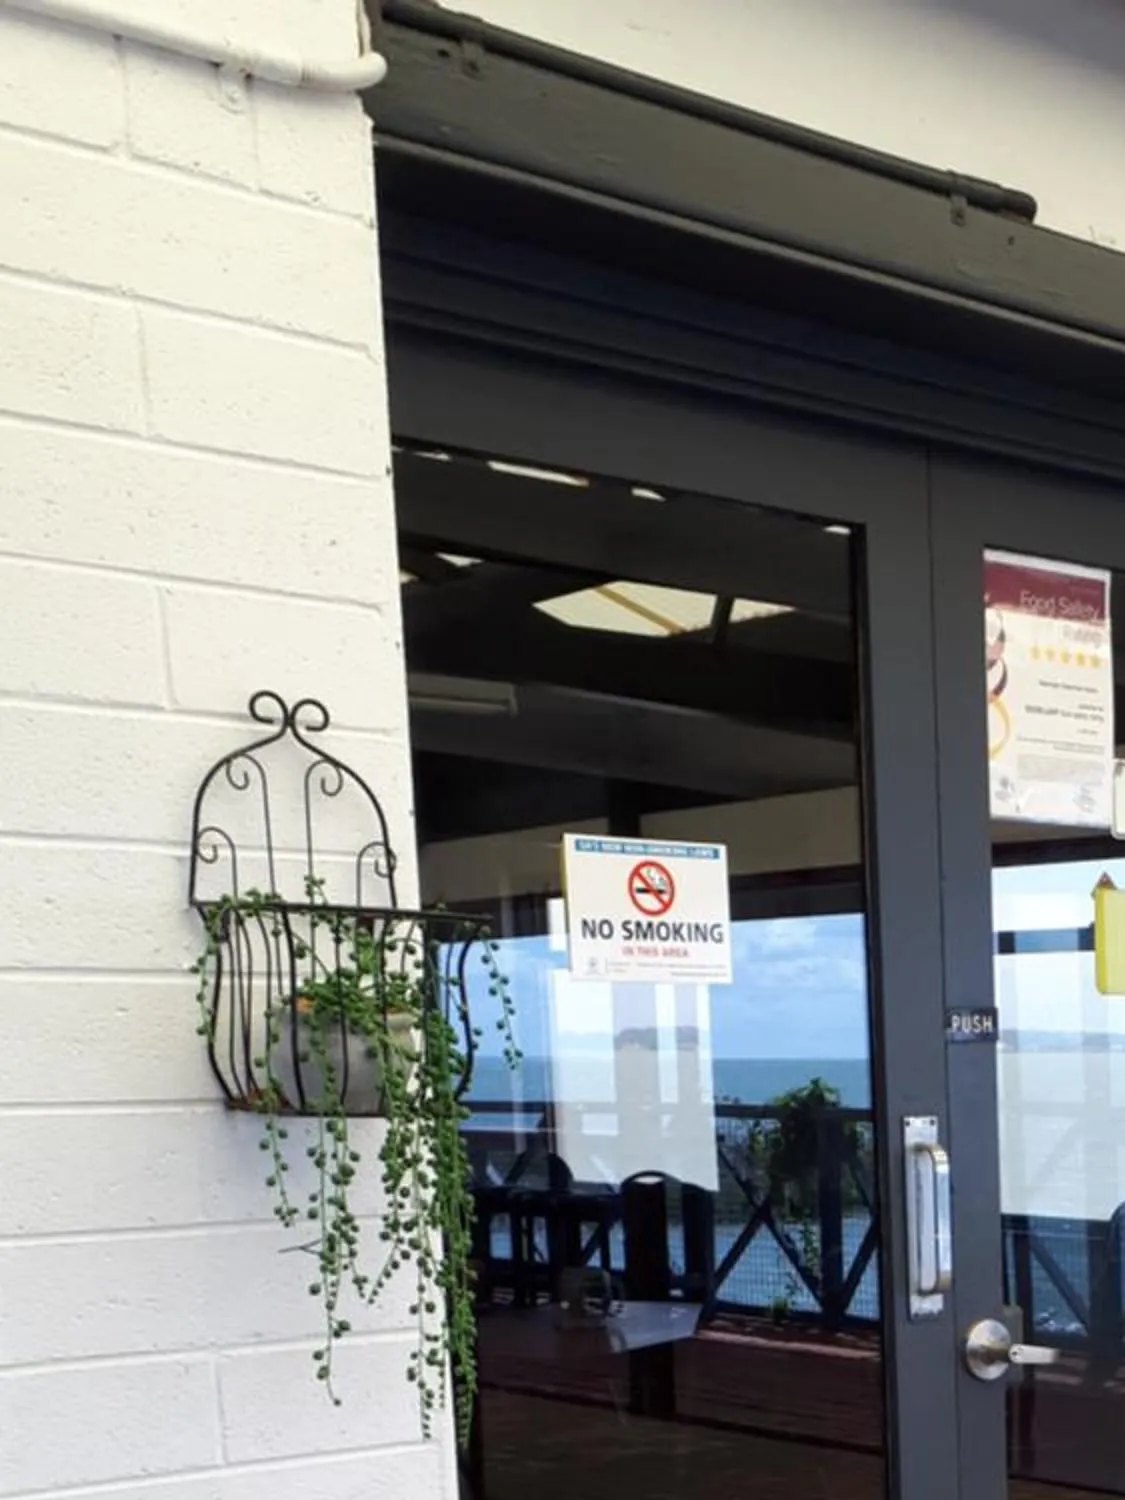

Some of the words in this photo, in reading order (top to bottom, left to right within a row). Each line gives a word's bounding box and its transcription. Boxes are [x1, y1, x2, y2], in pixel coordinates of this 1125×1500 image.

[581, 918, 615, 940] NO
[621, 919, 724, 944] SMOKING
[637, 946, 659, 957] THIS
[661, 946, 690, 958] AREA
[951, 1014, 993, 1033] PUSH
